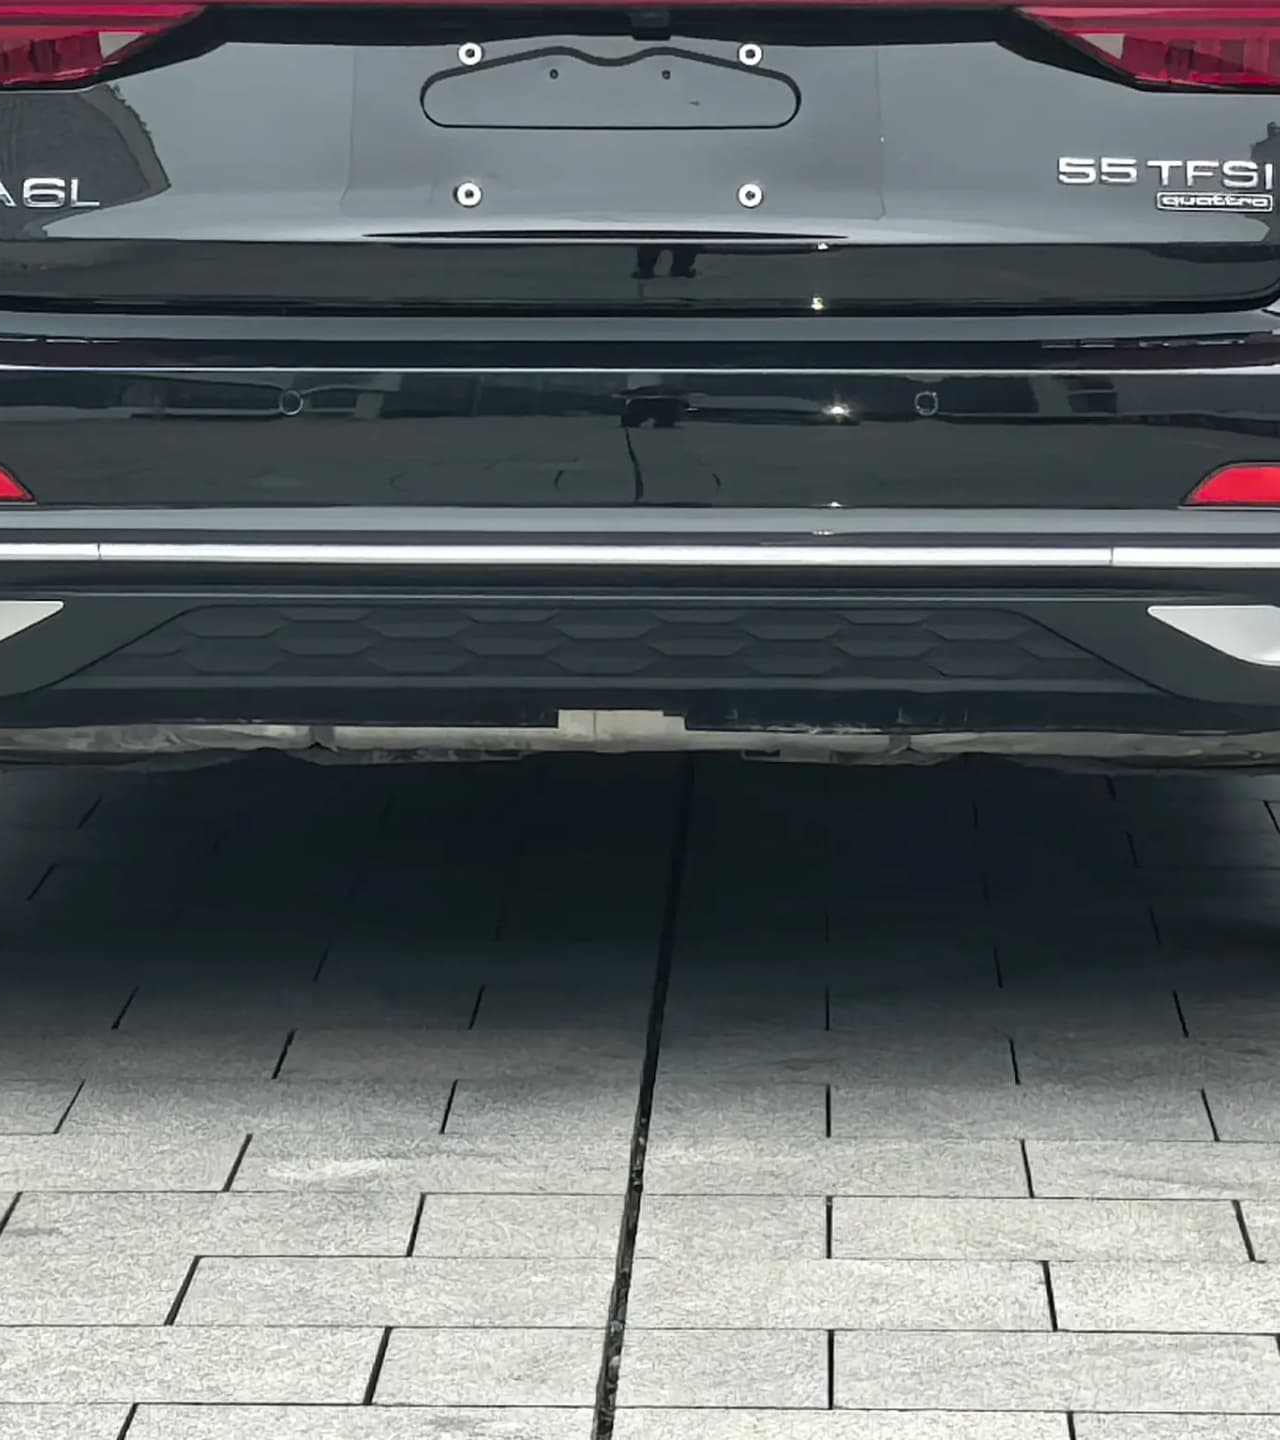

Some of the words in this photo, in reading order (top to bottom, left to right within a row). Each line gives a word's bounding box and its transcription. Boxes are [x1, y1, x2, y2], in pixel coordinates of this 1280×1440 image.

[1058, 157, 1138, 185] 55
[1146, 160, 1274, 191] TFSI
[1161, 194, 1270, 208] quattro
